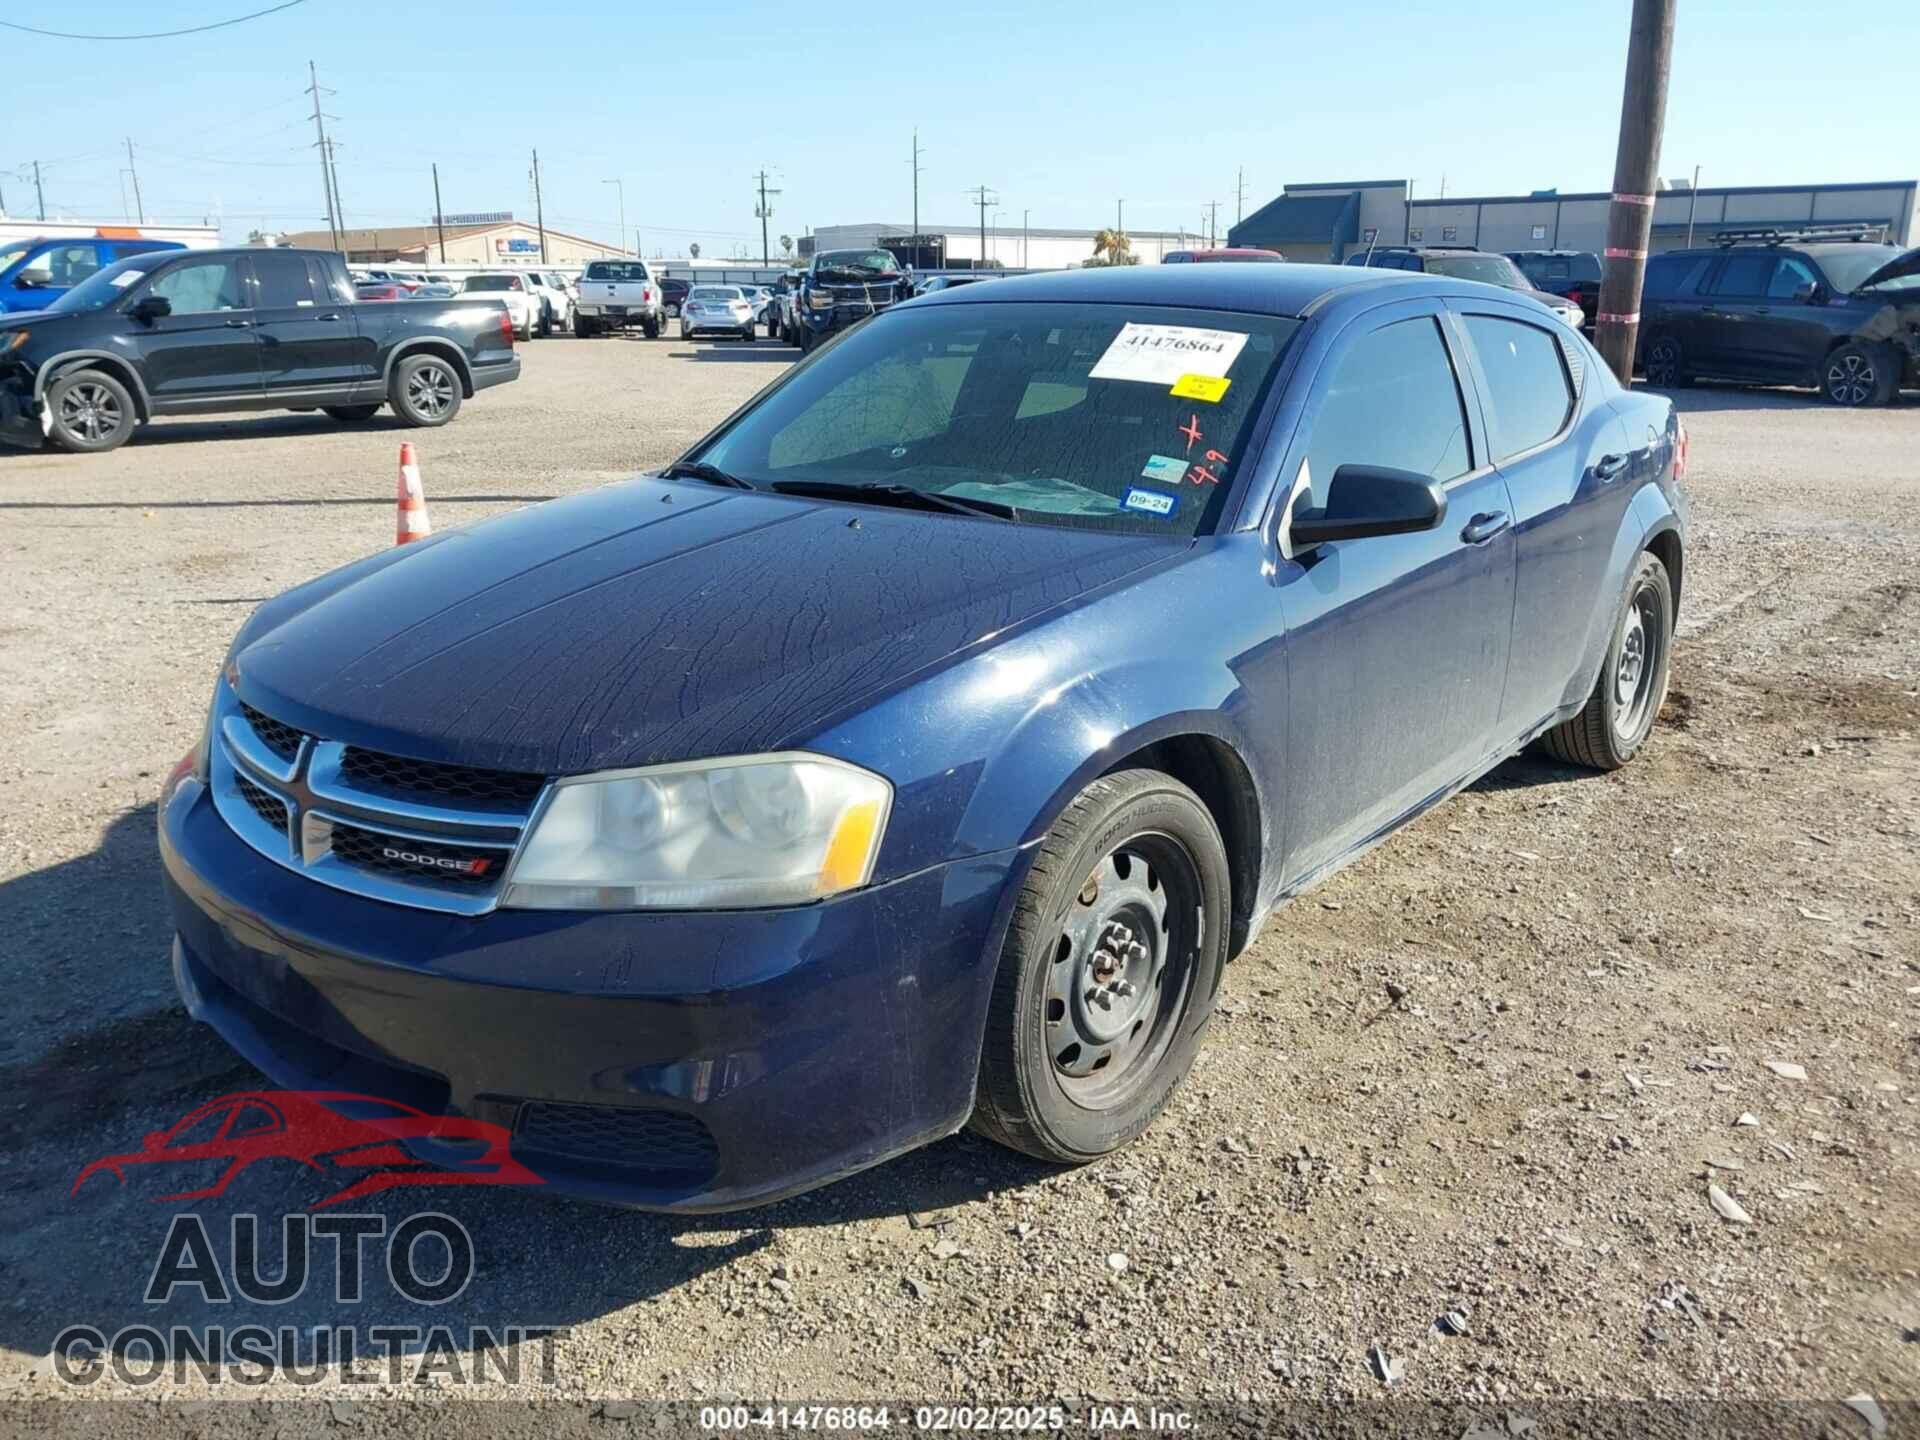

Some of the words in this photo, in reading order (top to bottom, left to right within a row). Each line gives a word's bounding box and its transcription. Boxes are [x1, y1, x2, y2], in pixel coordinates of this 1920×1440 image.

[1126, 335, 1225, 353] 41476864
[1130, 494, 1170, 510] 09-24
[383, 848, 473, 872] DODGE
